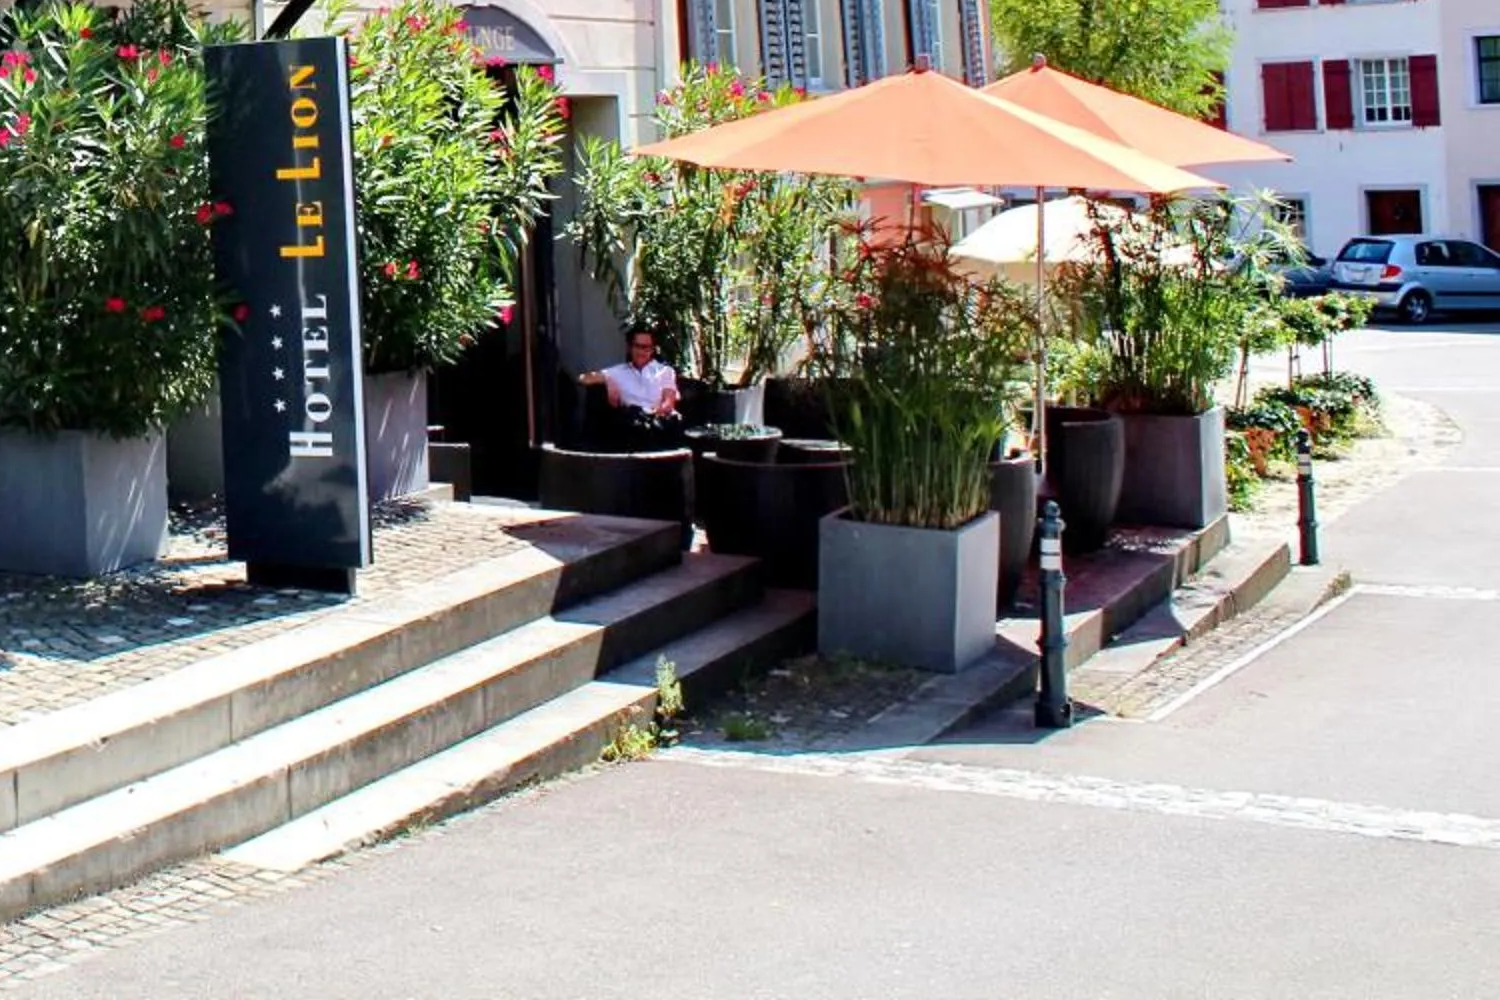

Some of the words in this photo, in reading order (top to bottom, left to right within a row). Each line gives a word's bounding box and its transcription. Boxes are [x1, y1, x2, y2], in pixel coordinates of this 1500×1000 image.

[276, 64, 322, 180] LION
[280, 201, 325, 258] LE
[289, 294, 334, 457] HOTEL
